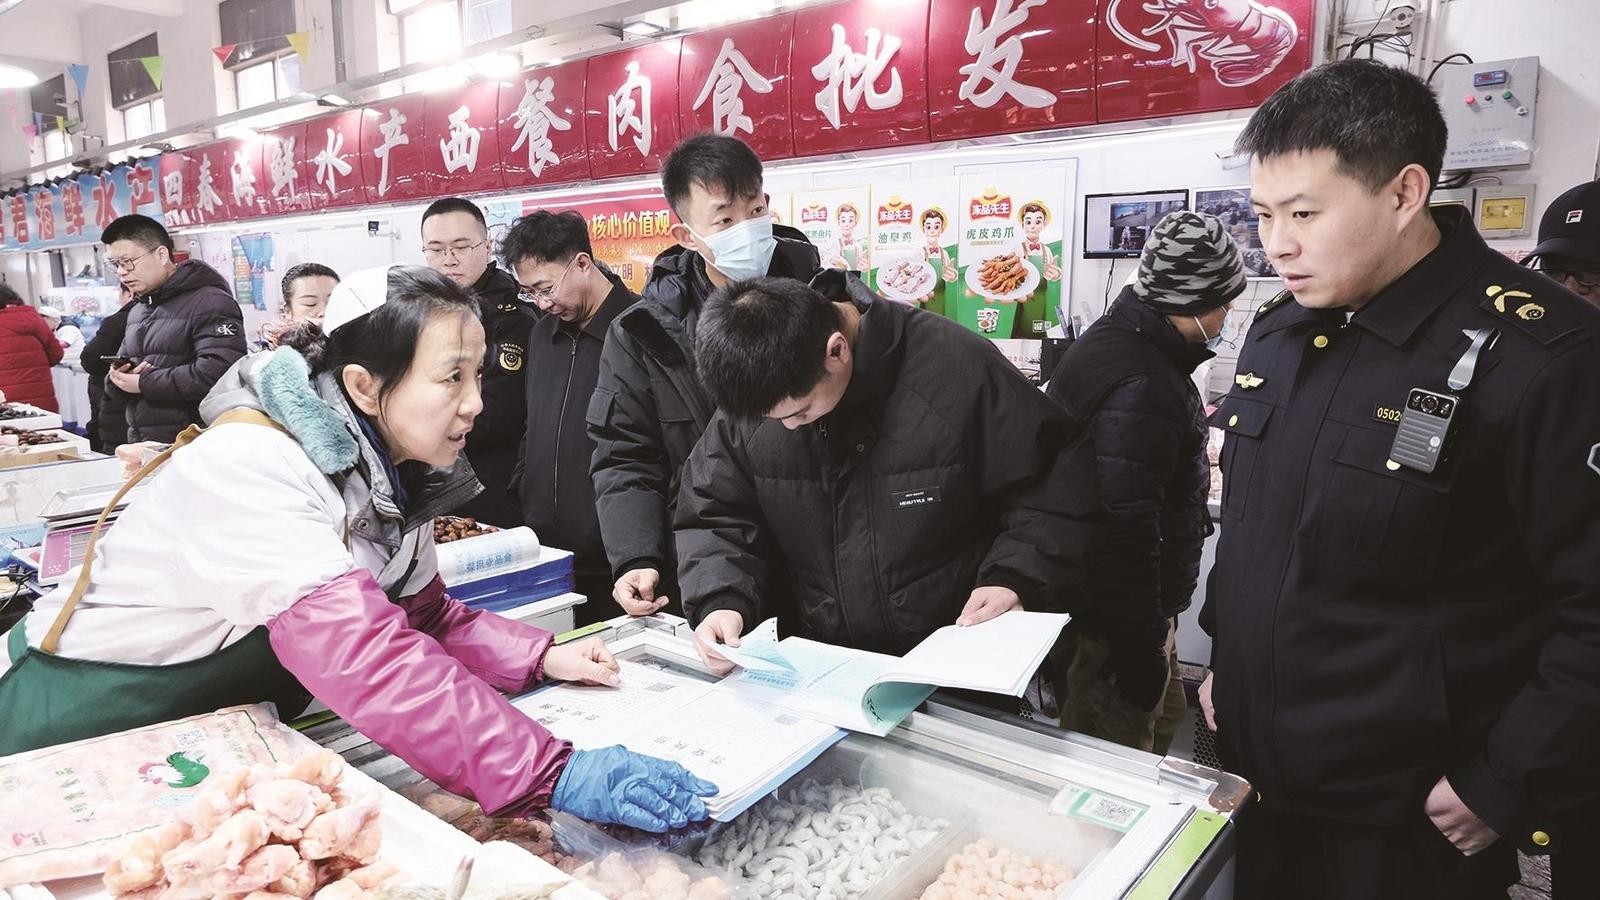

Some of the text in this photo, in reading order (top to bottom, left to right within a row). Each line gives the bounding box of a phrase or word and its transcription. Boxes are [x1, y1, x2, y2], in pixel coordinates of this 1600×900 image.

[971, 202, 1010, 216] 冻品先生
[587, 209, 671, 241] 核心价值观
[966, 226, 1015, 240] 虎皮鸡爪
[1377, 407, 1403, 421] 0502
